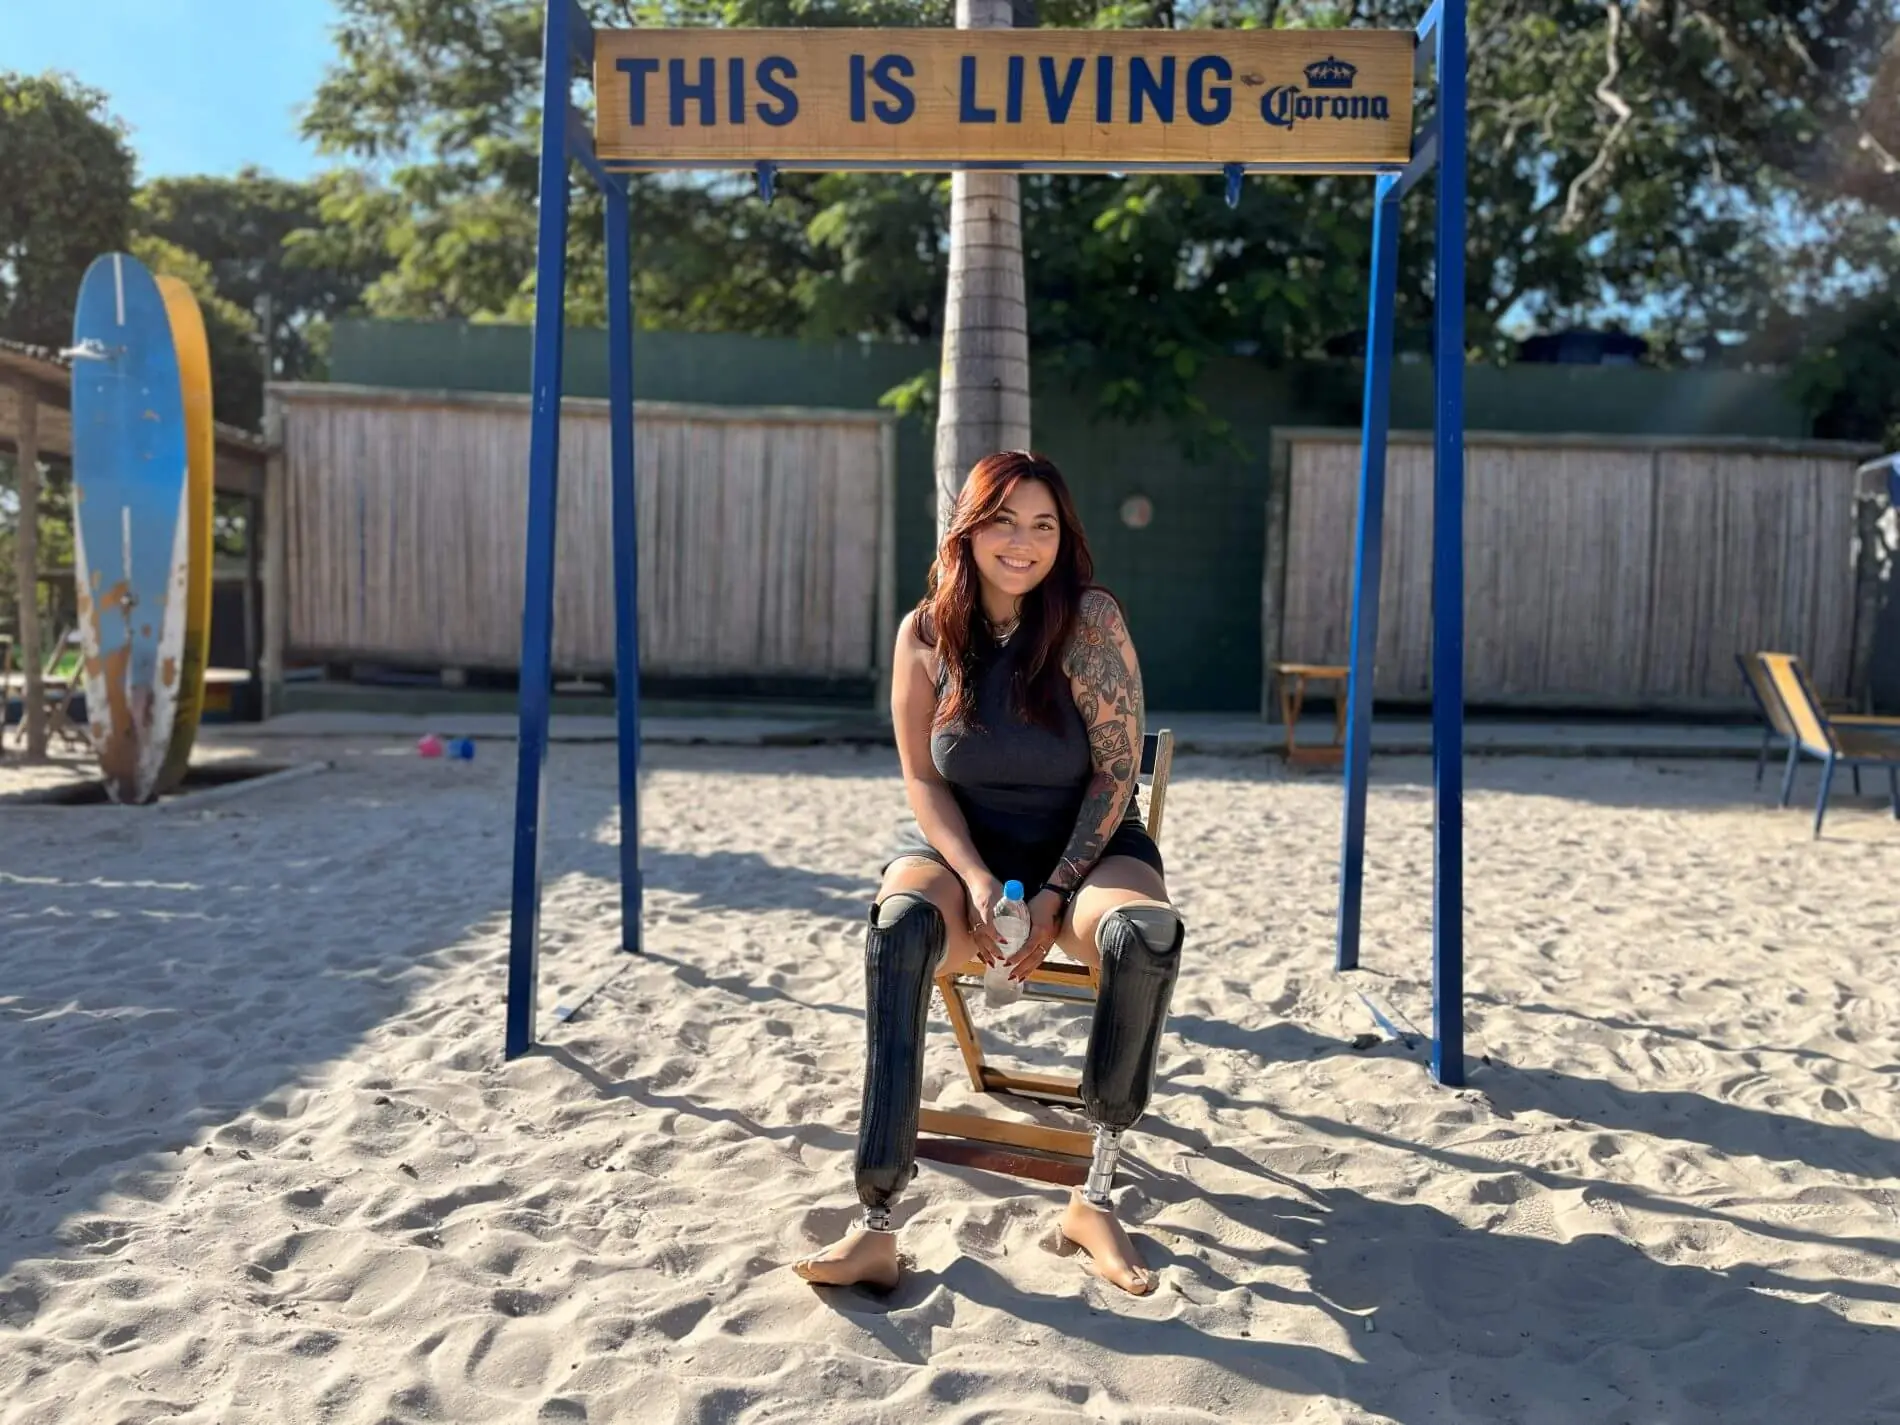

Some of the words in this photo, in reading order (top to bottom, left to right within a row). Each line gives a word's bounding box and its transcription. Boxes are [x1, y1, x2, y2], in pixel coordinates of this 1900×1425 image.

[615, 56, 799, 127] THIS
[849, 54, 916, 125] IS
[959, 54, 1233, 126] LIVING
[1260, 86, 1390, 130] Corona
